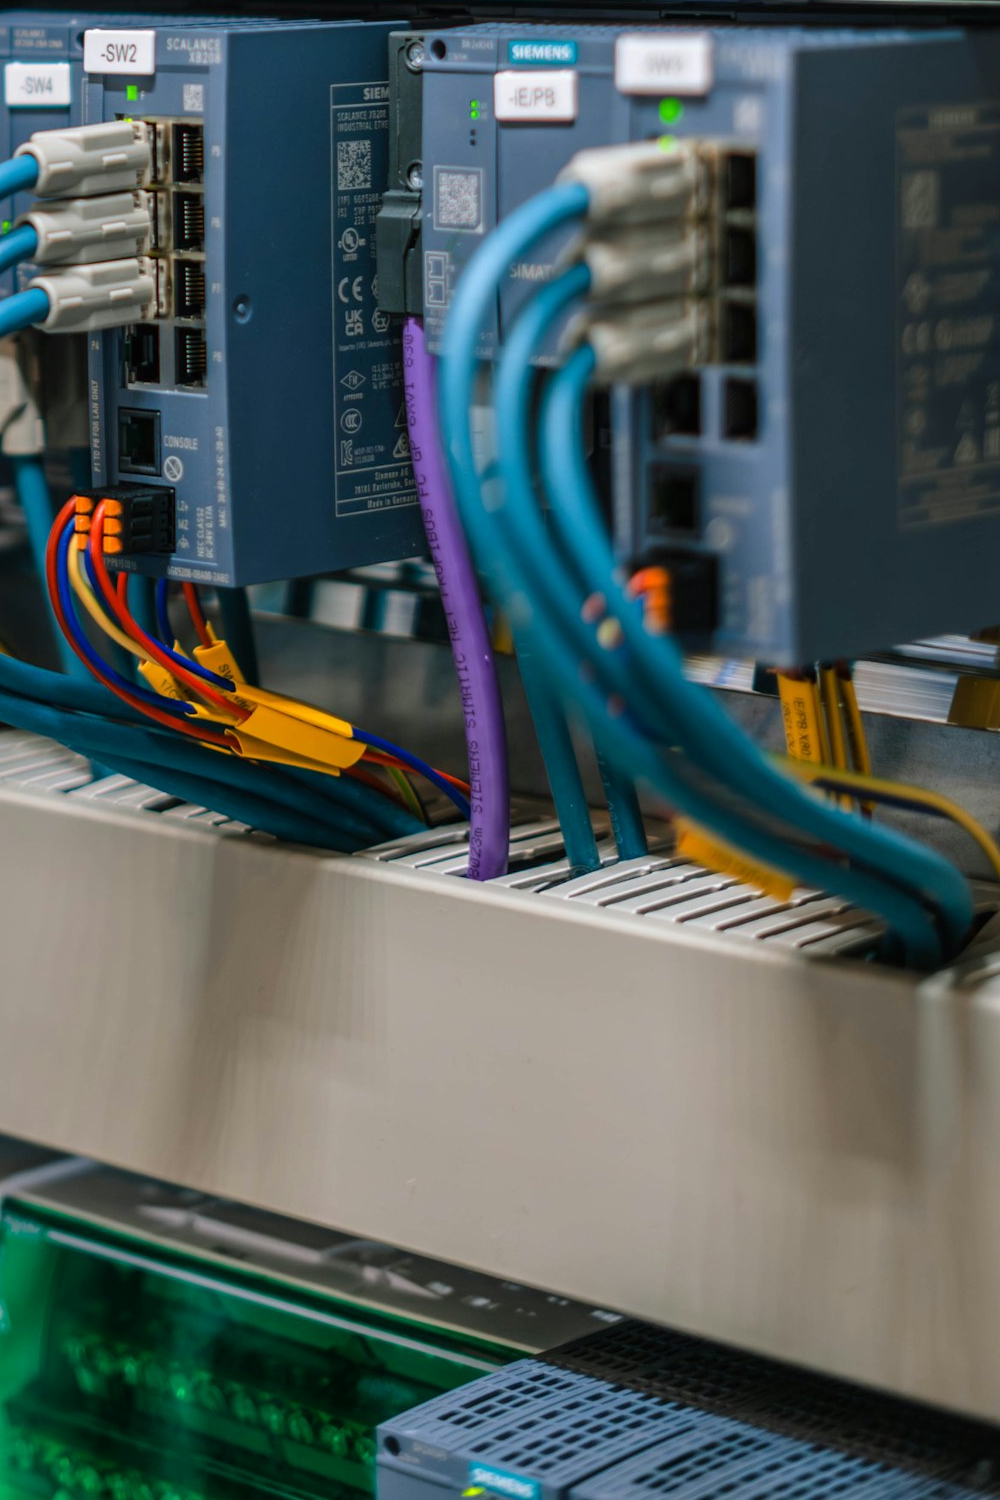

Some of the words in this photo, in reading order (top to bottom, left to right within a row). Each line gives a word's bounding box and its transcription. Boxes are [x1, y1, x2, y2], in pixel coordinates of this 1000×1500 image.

[166, 37, 222, 51] SCALANCE
[511, 44, 571, 61] SIEMENS
[100, 44, 137, 63] -SW2
[20, 76, 53, 94] -SW4
[337, 110, 367, 122] SCALANCE
[337, 121, 372, 133] INDUSTRIAL
[345, 309, 363, 323] UK
[345, 322, 364, 337] CA
[90, 379, 99, 401] ONLY
[91, 401, 100, 420] LAN
[92, 420, 101, 437] FOR
[163, 435, 199, 451] CONSOLE
[408, 440, 424, 462] GP
[374, 470, 399, 481] Siemens
[400, 468, 409, 478] AG
[372, 479, 403, 492] Karlsruhe,
[414, 473, 430, 498] FC
[367, 497, 383, 509] Made
[385, 497, 391, 507] in
[393, 495, 417, 508] Germany
[196, 507, 204, 539] CLASS2
[205, 529, 214, 546] 24V
[196, 540, 205, 558] NEC
[205, 547, 214, 559] DC
[445, 611, 462, 642] NET
[453, 652, 477, 730] SIMATIC
[468, 739, 484, 814] SIEMENS
